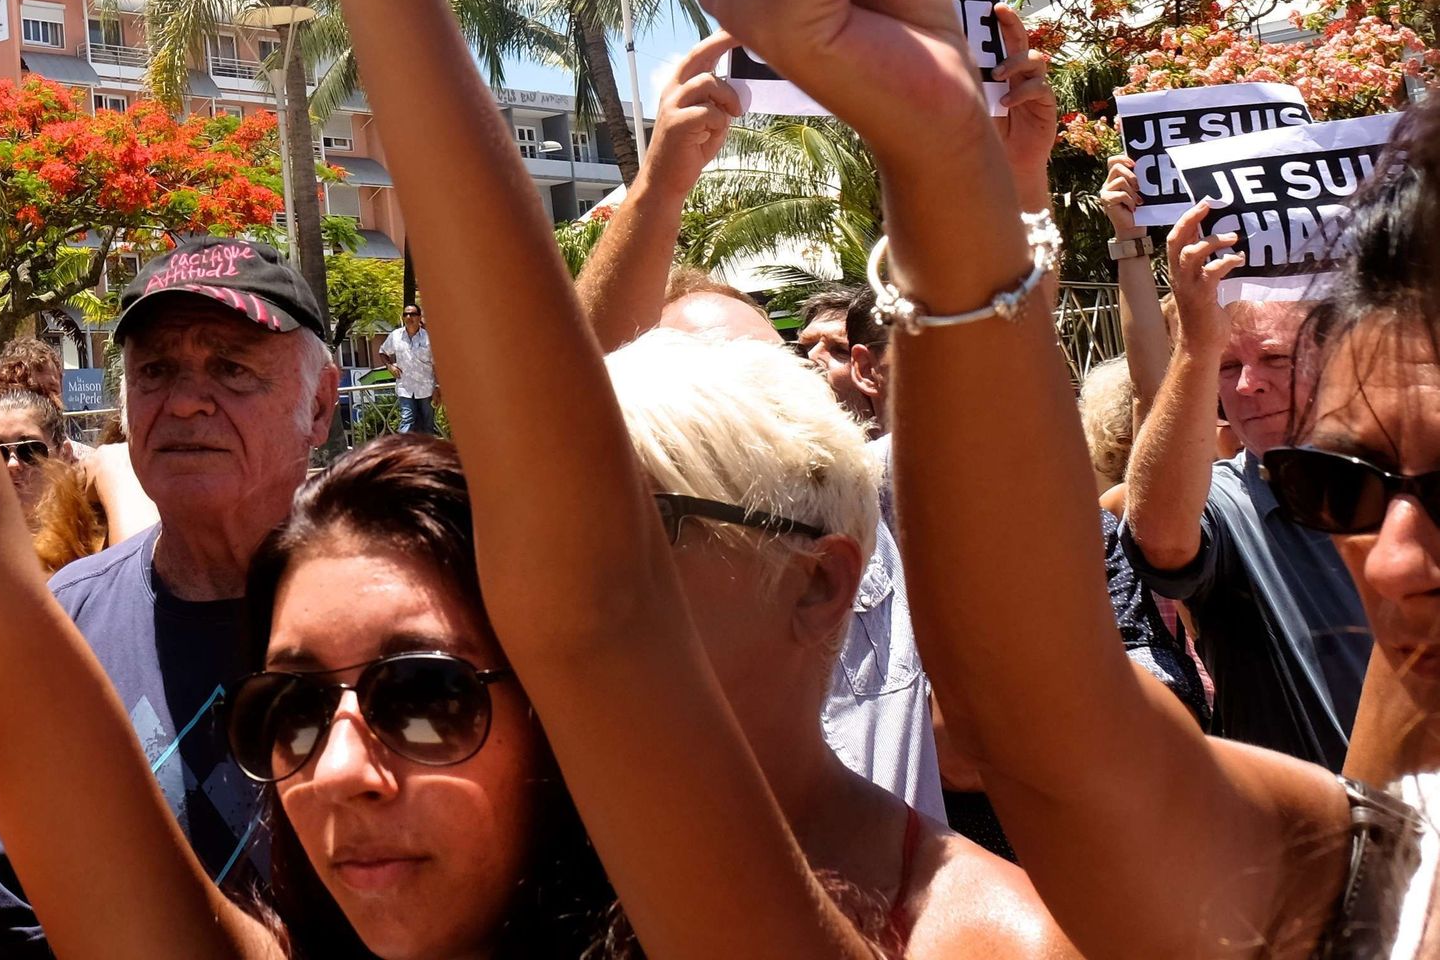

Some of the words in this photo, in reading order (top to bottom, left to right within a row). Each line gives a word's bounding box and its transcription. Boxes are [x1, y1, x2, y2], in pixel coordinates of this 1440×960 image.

[1128, 116, 1190, 150] JE
[1199, 107, 1309, 140] SUIS
[1206, 165, 1278, 209] JE
[1280, 153, 1403, 201] SUI
[145, 263, 241, 294] Attitude
[68, 381, 102, 392] Maison
[80, 392, 102, 404] Perle
